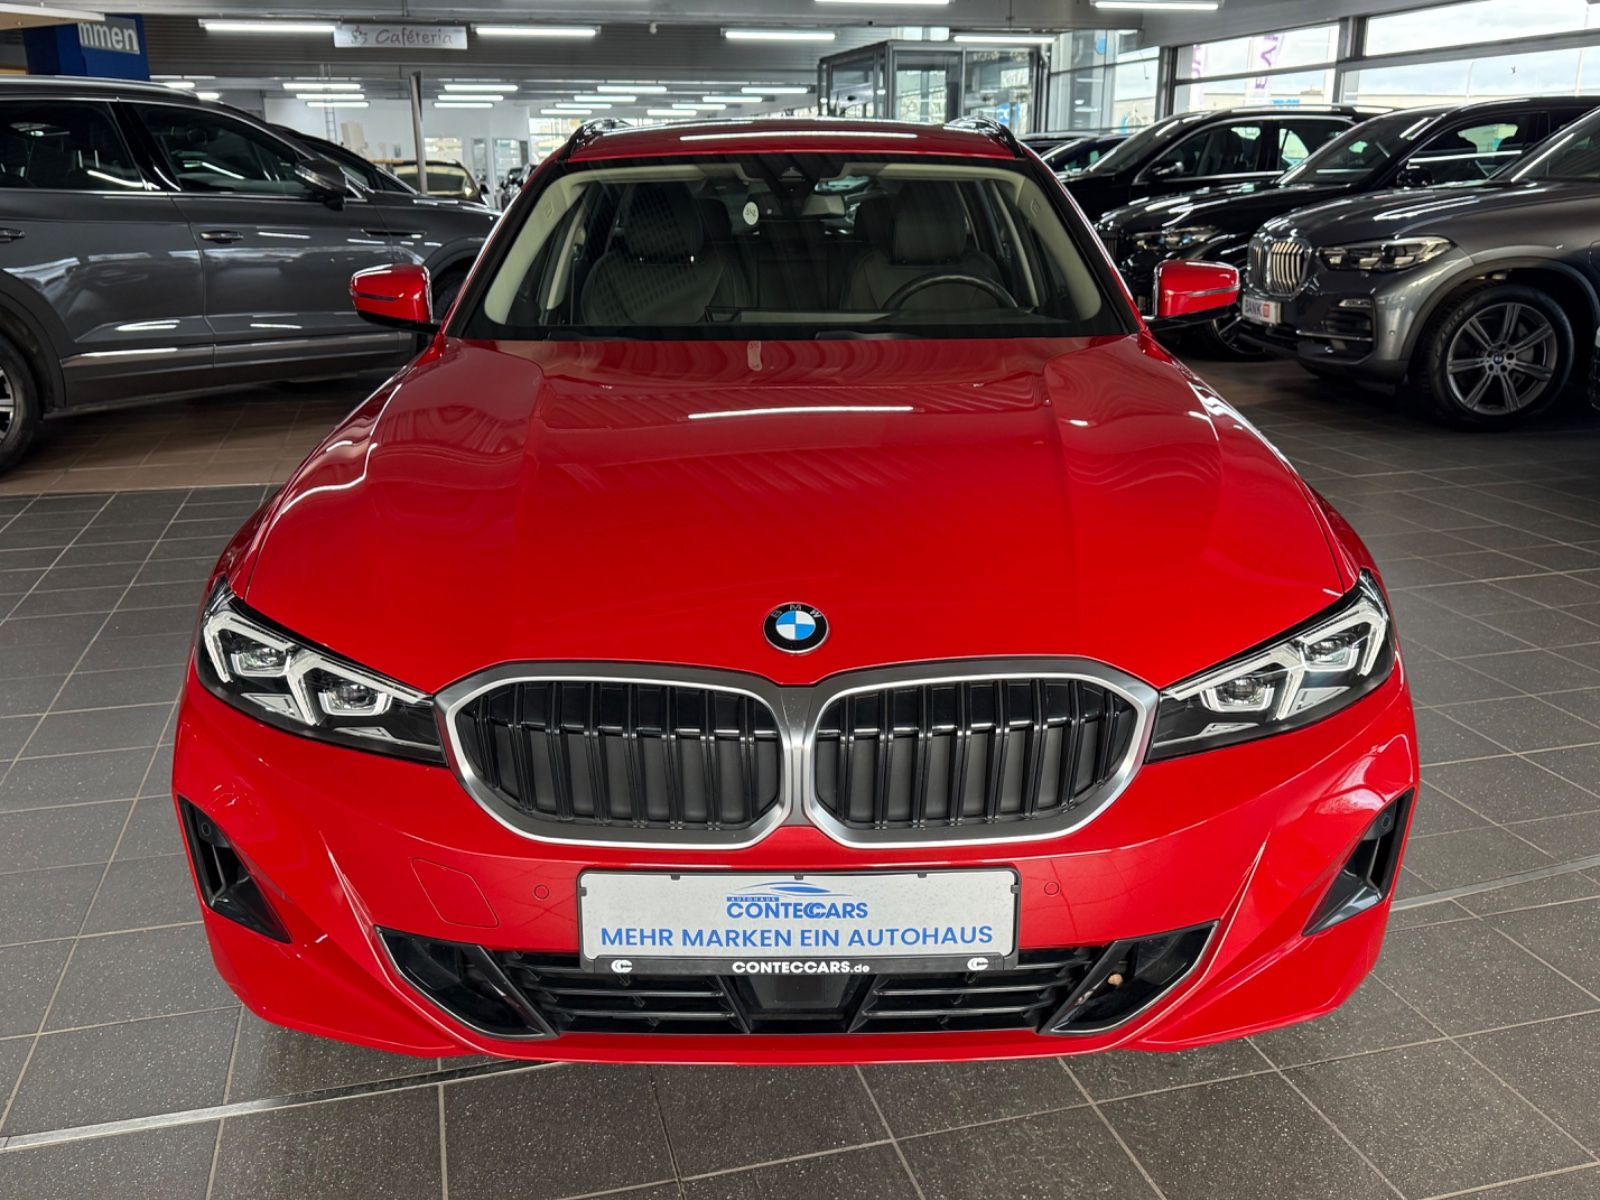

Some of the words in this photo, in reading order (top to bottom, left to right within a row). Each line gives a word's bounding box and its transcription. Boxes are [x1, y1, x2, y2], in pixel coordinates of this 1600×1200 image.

[771, 604, 822, 618] BMW
[601, 927, 674, 946] MEHR
[681, 929, 792, 947] MARKEN
[800, 929, 840, 947] EIN
[848, 925, 993, 946] AUTOHAUS
[732, 961, 870, 974] CONTECCARS.de
